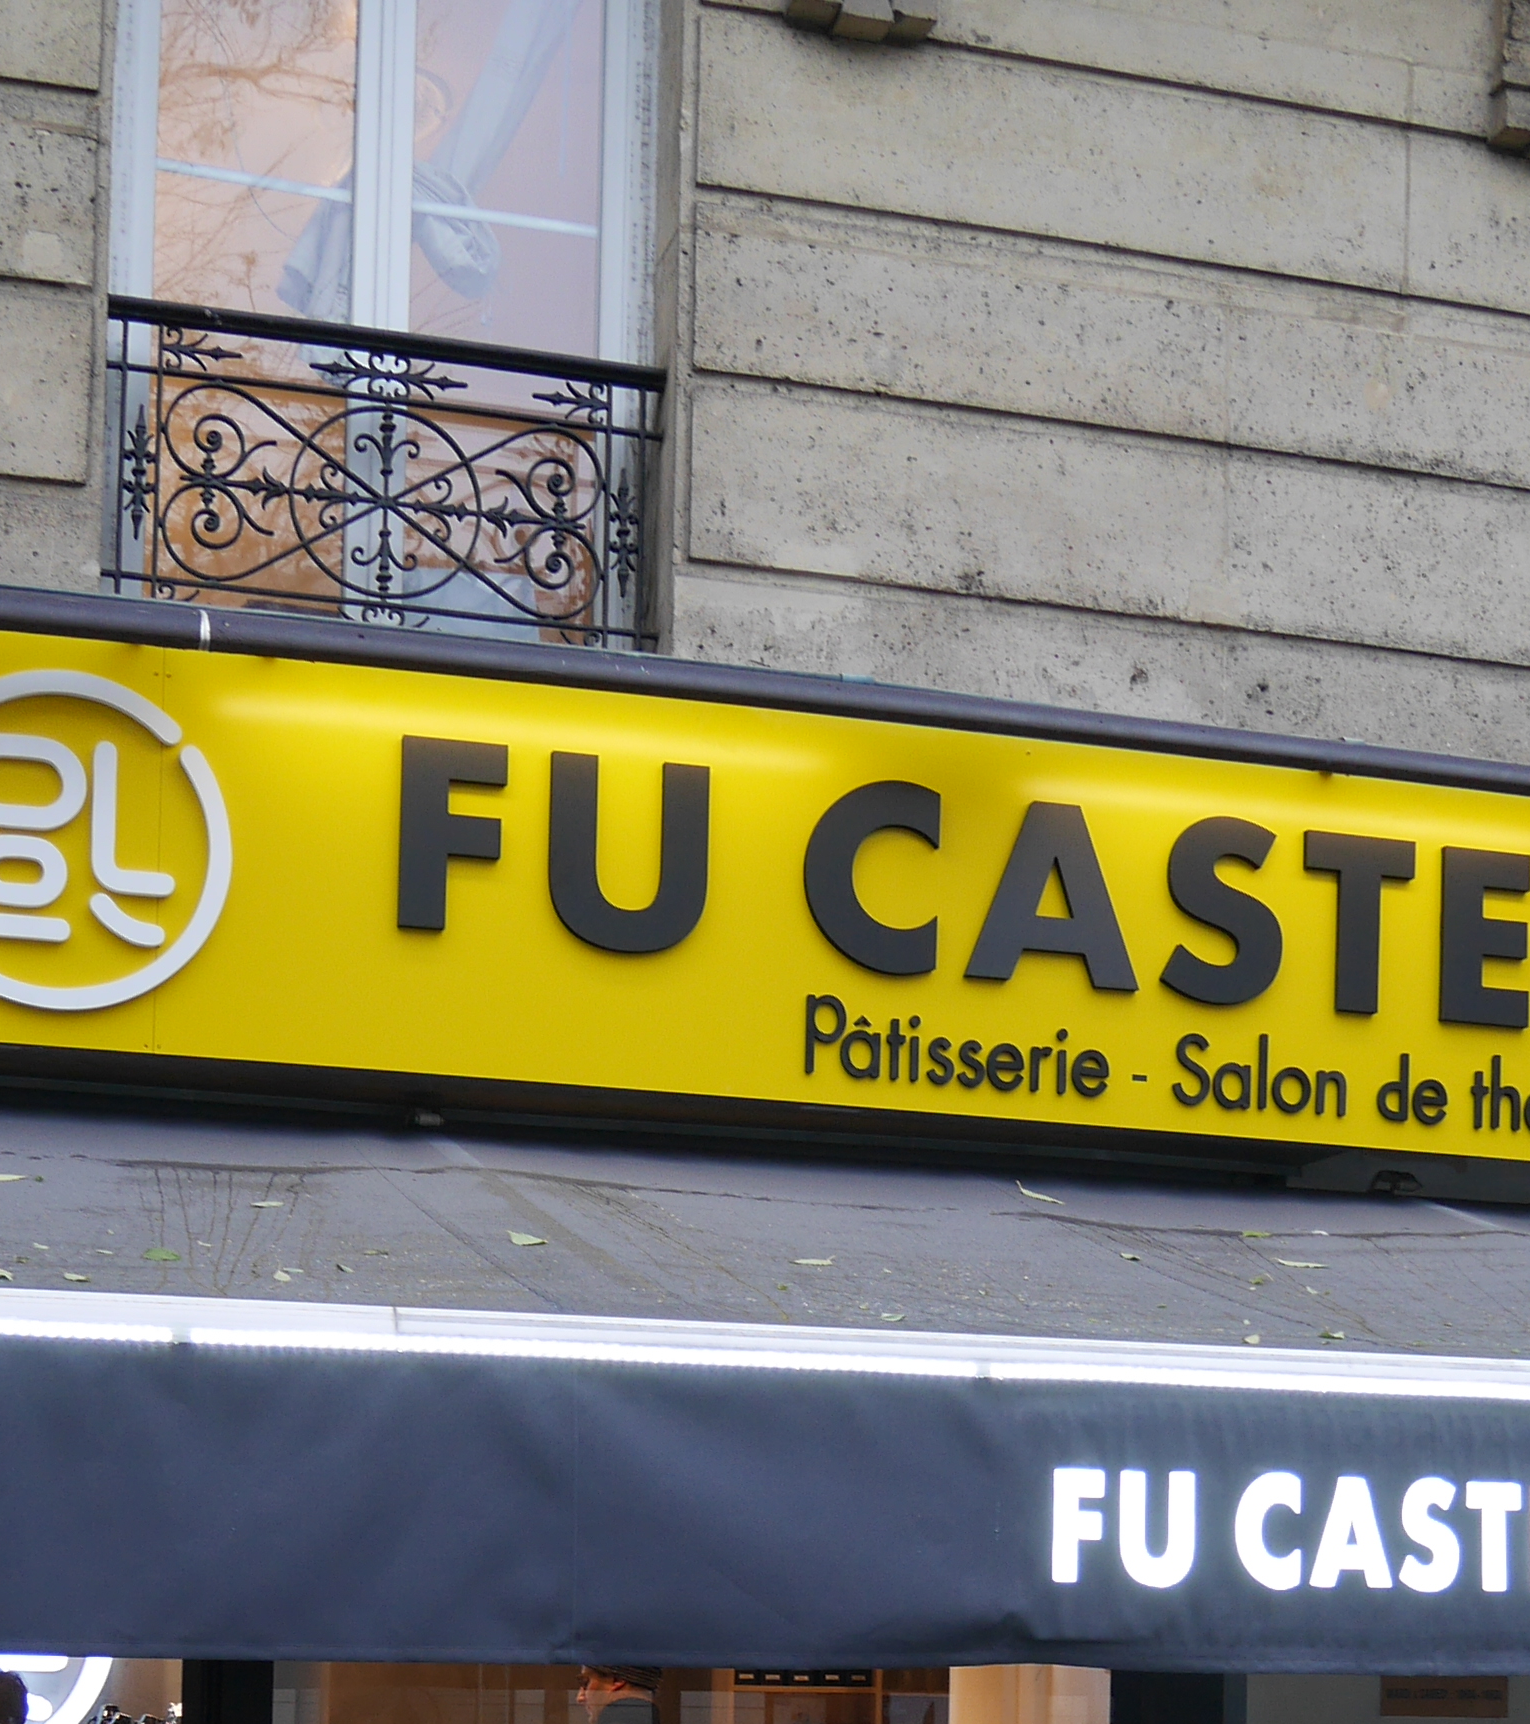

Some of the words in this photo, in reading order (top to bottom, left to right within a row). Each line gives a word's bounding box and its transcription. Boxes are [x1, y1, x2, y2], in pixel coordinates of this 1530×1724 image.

[396, 735, 710, 954] FU
[804, 994, 1110, 1099] Pâtisserie
[1171, 1033, 1347, 1119] Salon
[1376, 1053, 1448, 1127] de
[1051, 1464, 1201, 1589] FU
